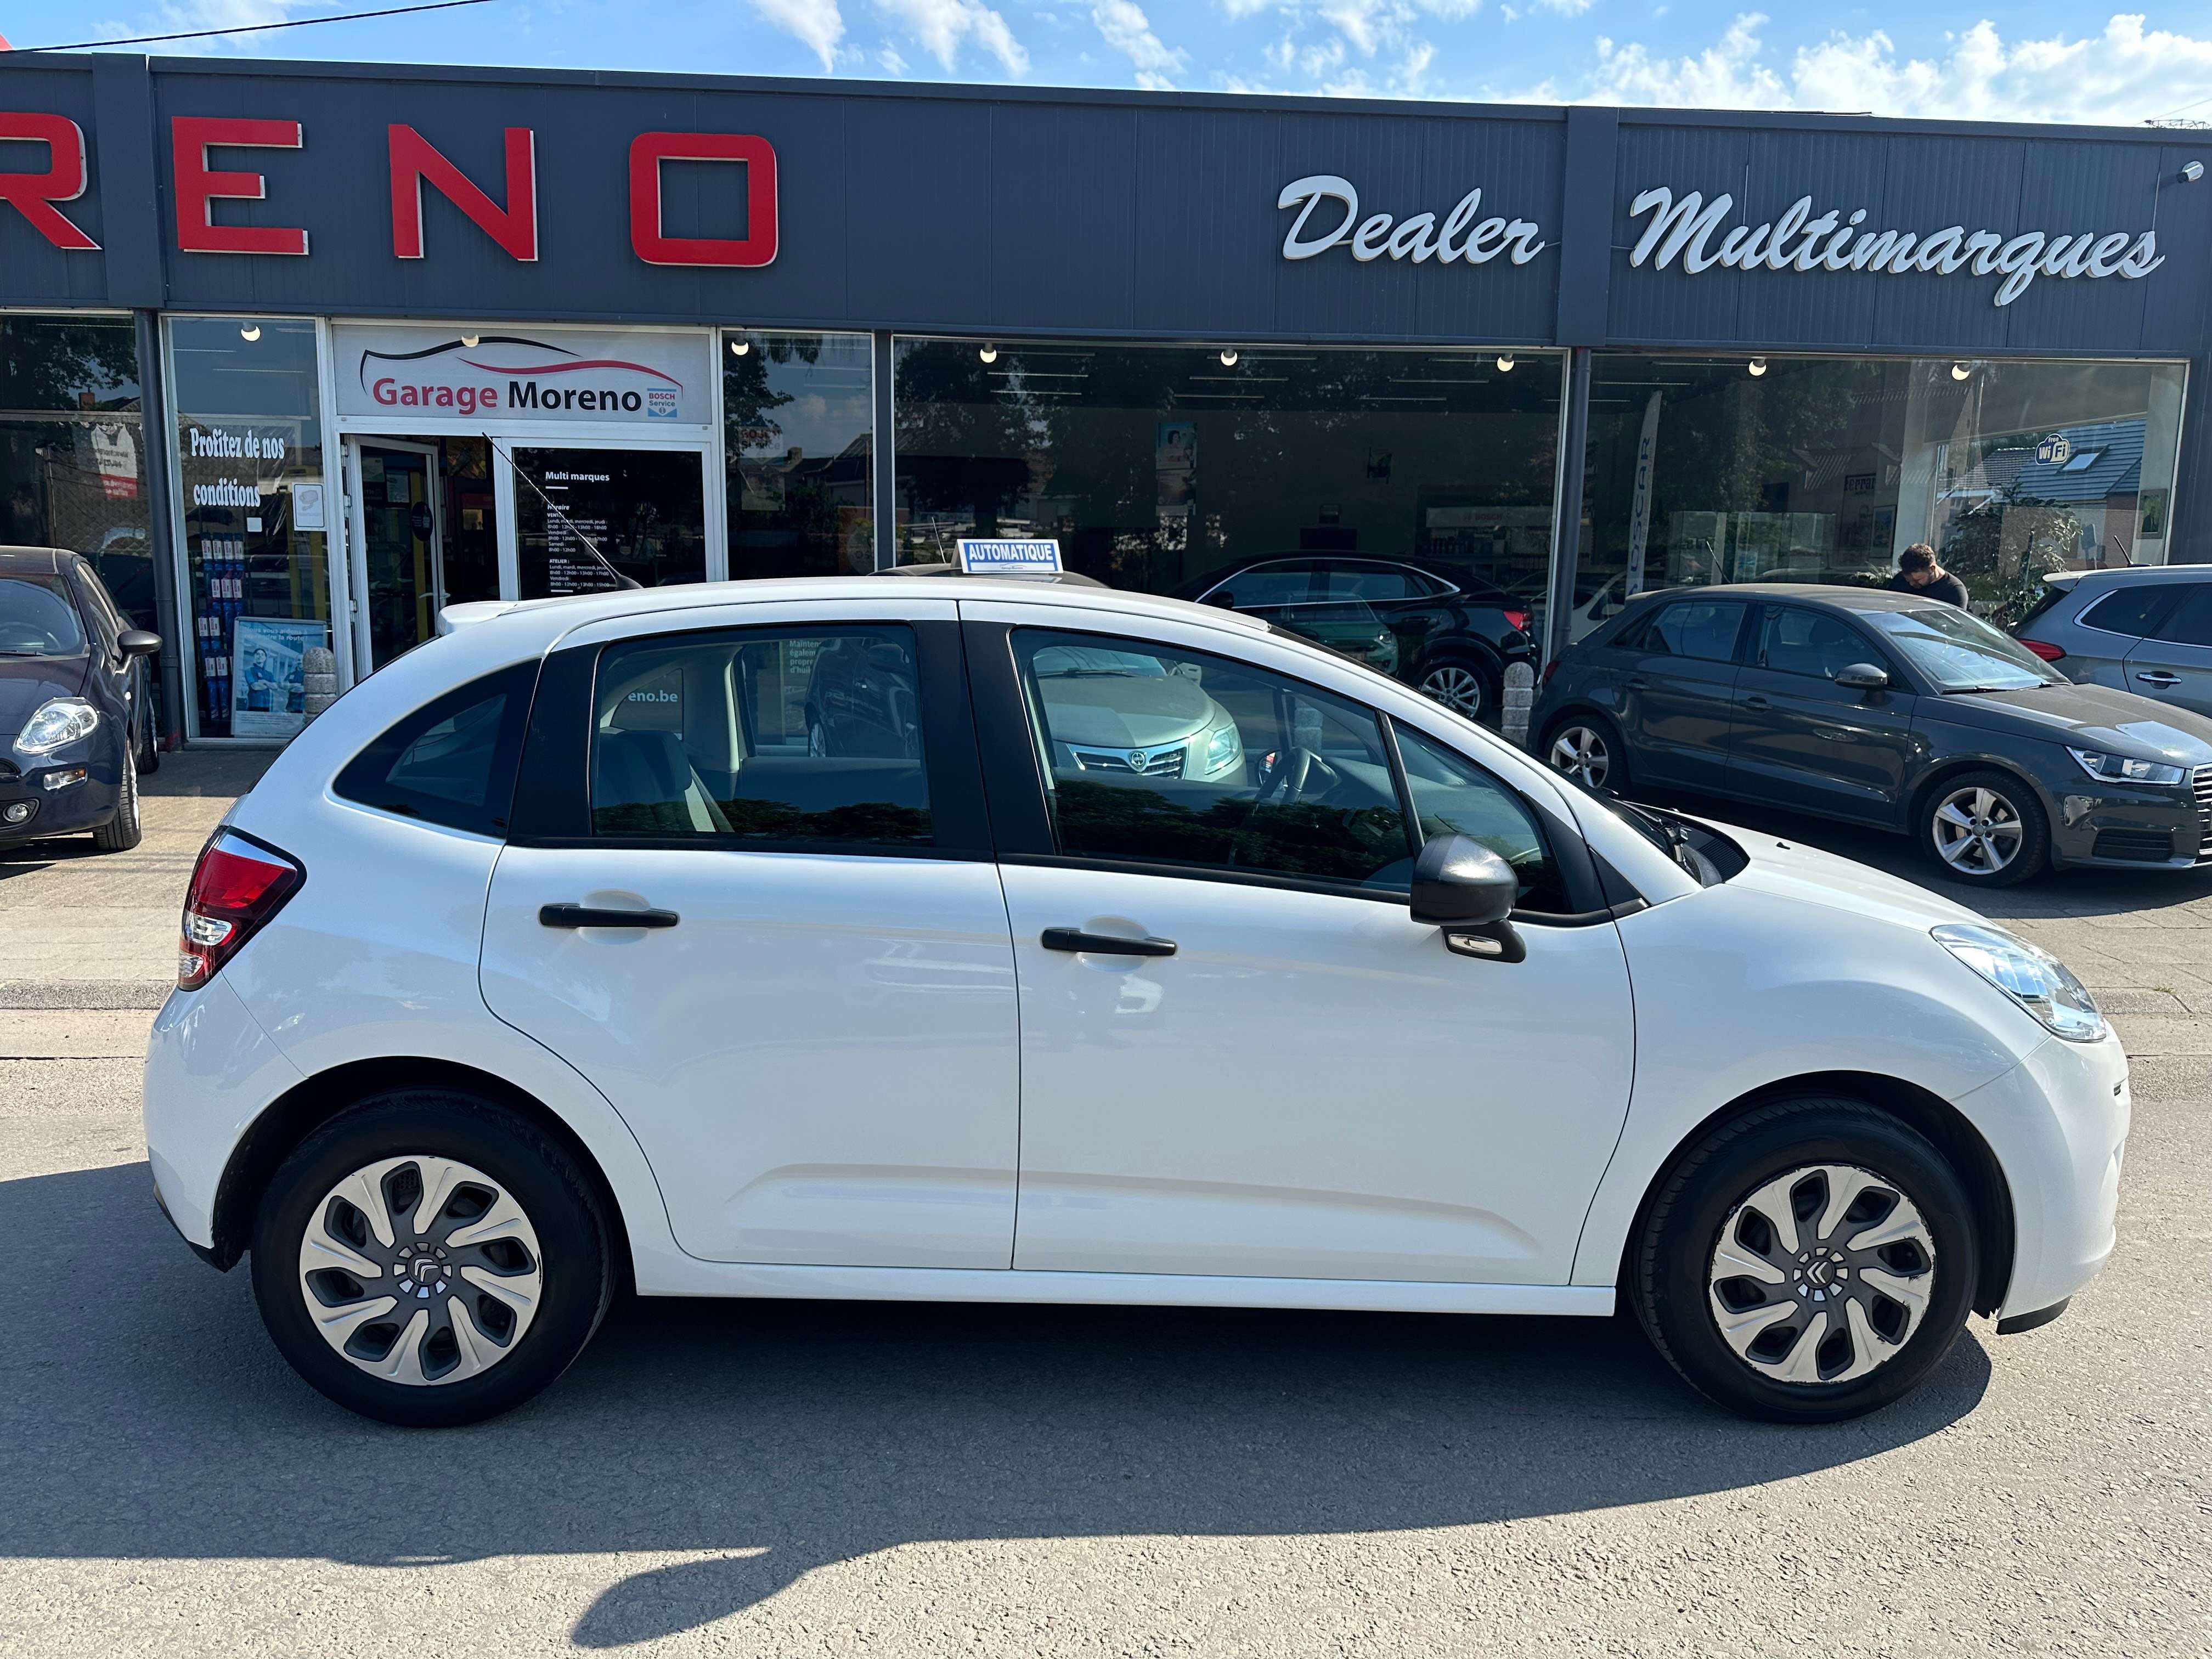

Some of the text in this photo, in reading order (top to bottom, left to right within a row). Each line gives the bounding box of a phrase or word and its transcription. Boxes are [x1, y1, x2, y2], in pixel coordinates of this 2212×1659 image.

[1278, 175, 2165, 307] Dealer Multimarques
[373, 378, 641, 415] Garage Moreno
[190, 428, 284, 459] Profitez de nos
[545, 471, 610, 482] Multi marques
[193, 478, 261, 507] conditions
[969, 544, 1053, 561] AUTOMATIQUE
[628, 690, 679, 702] eno.be
